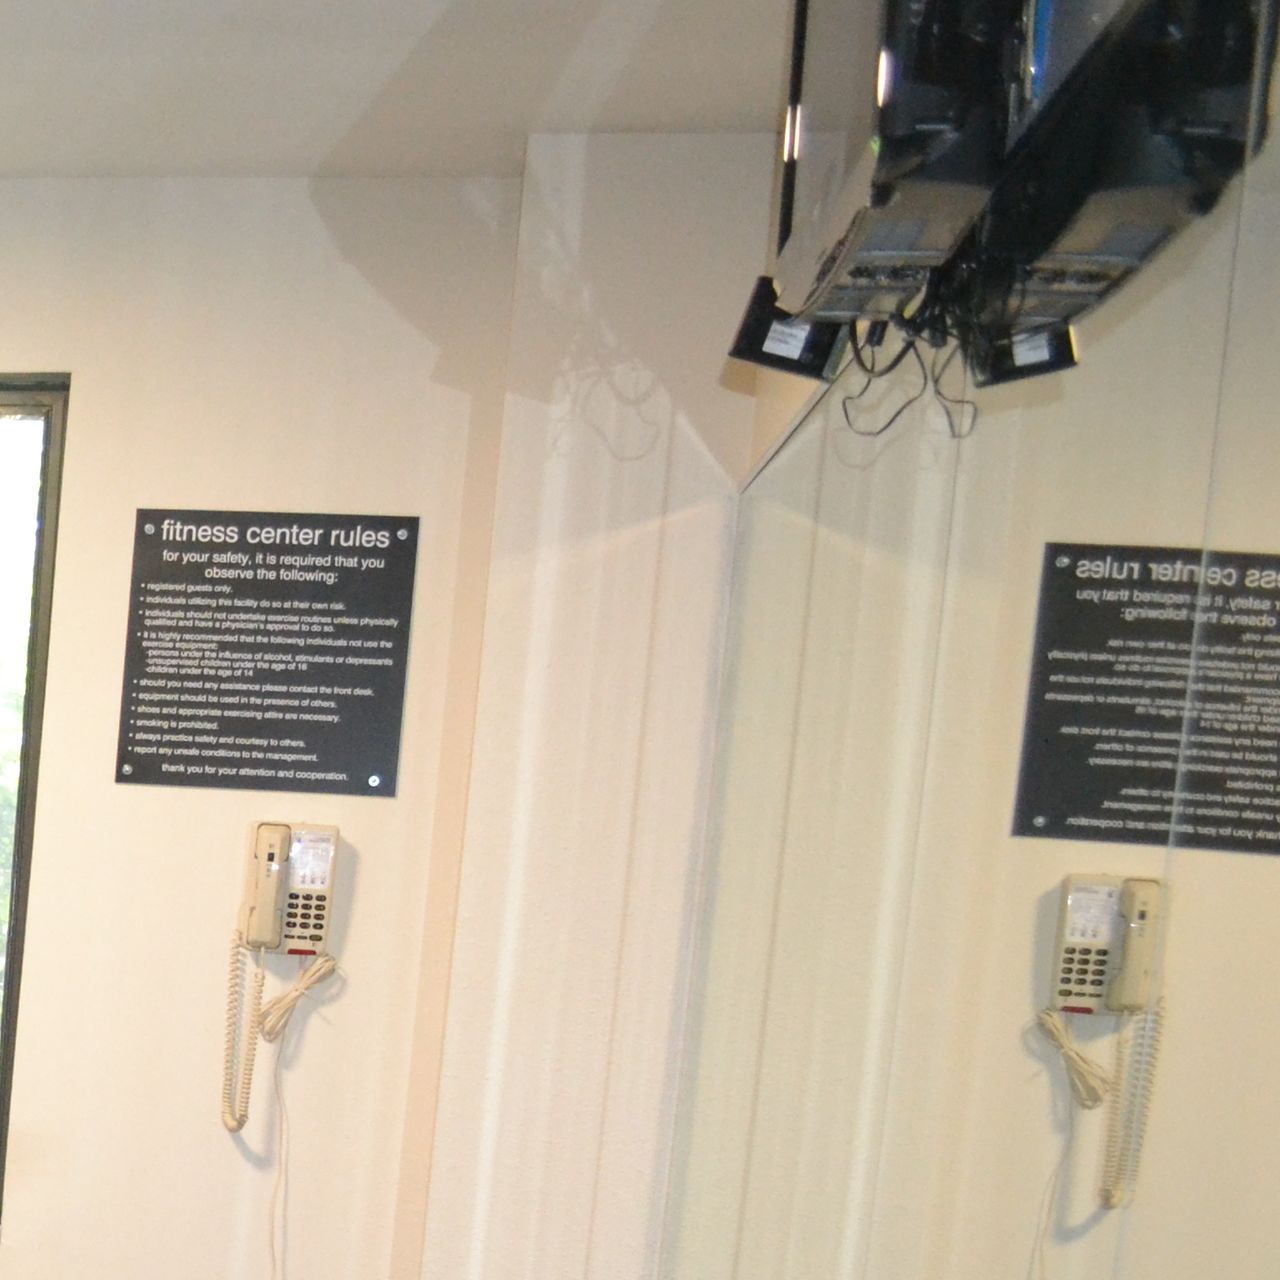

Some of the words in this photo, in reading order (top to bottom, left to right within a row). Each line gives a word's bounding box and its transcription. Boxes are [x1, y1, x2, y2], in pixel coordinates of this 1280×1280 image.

[160, 519, 240, 543] fitness
[246, 522, 324, 546] center
[330, 524, 391, 548] rules
[162, 550, 179, 562] for
[181, 553, 209, 566] your
[211, 551, 252, 567] safety,
[255, 553, 264, 564] it
[265, 553, 278, 565] is
[278, 554, 332, 570] required
[334, 555, 359, 568] that
[360, 559, 385, 572] you
[204, 566, 255, 579] observe
[256, 568, 278, 580] the
[279, 569, 339, 585] following:
